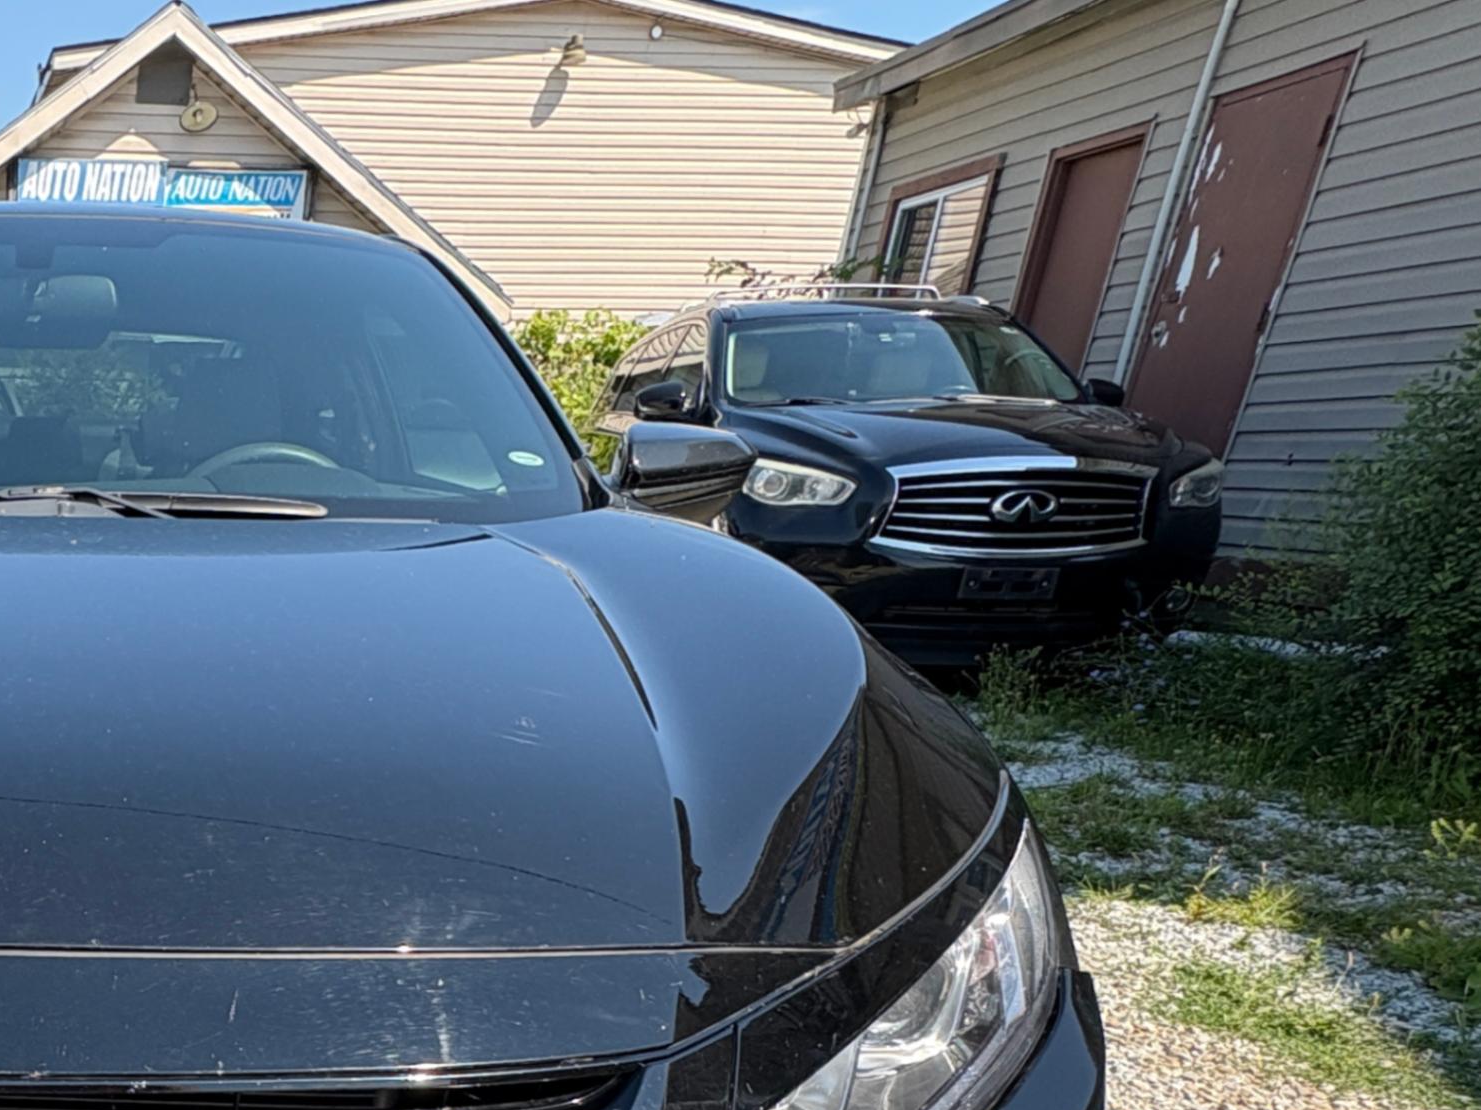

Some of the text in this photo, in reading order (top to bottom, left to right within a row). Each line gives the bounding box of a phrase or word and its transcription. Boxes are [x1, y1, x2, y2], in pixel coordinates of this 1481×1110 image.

[21, 161, 160, 203] AUTO NATION
[171, 174, 299, 203] AUTO NATION
